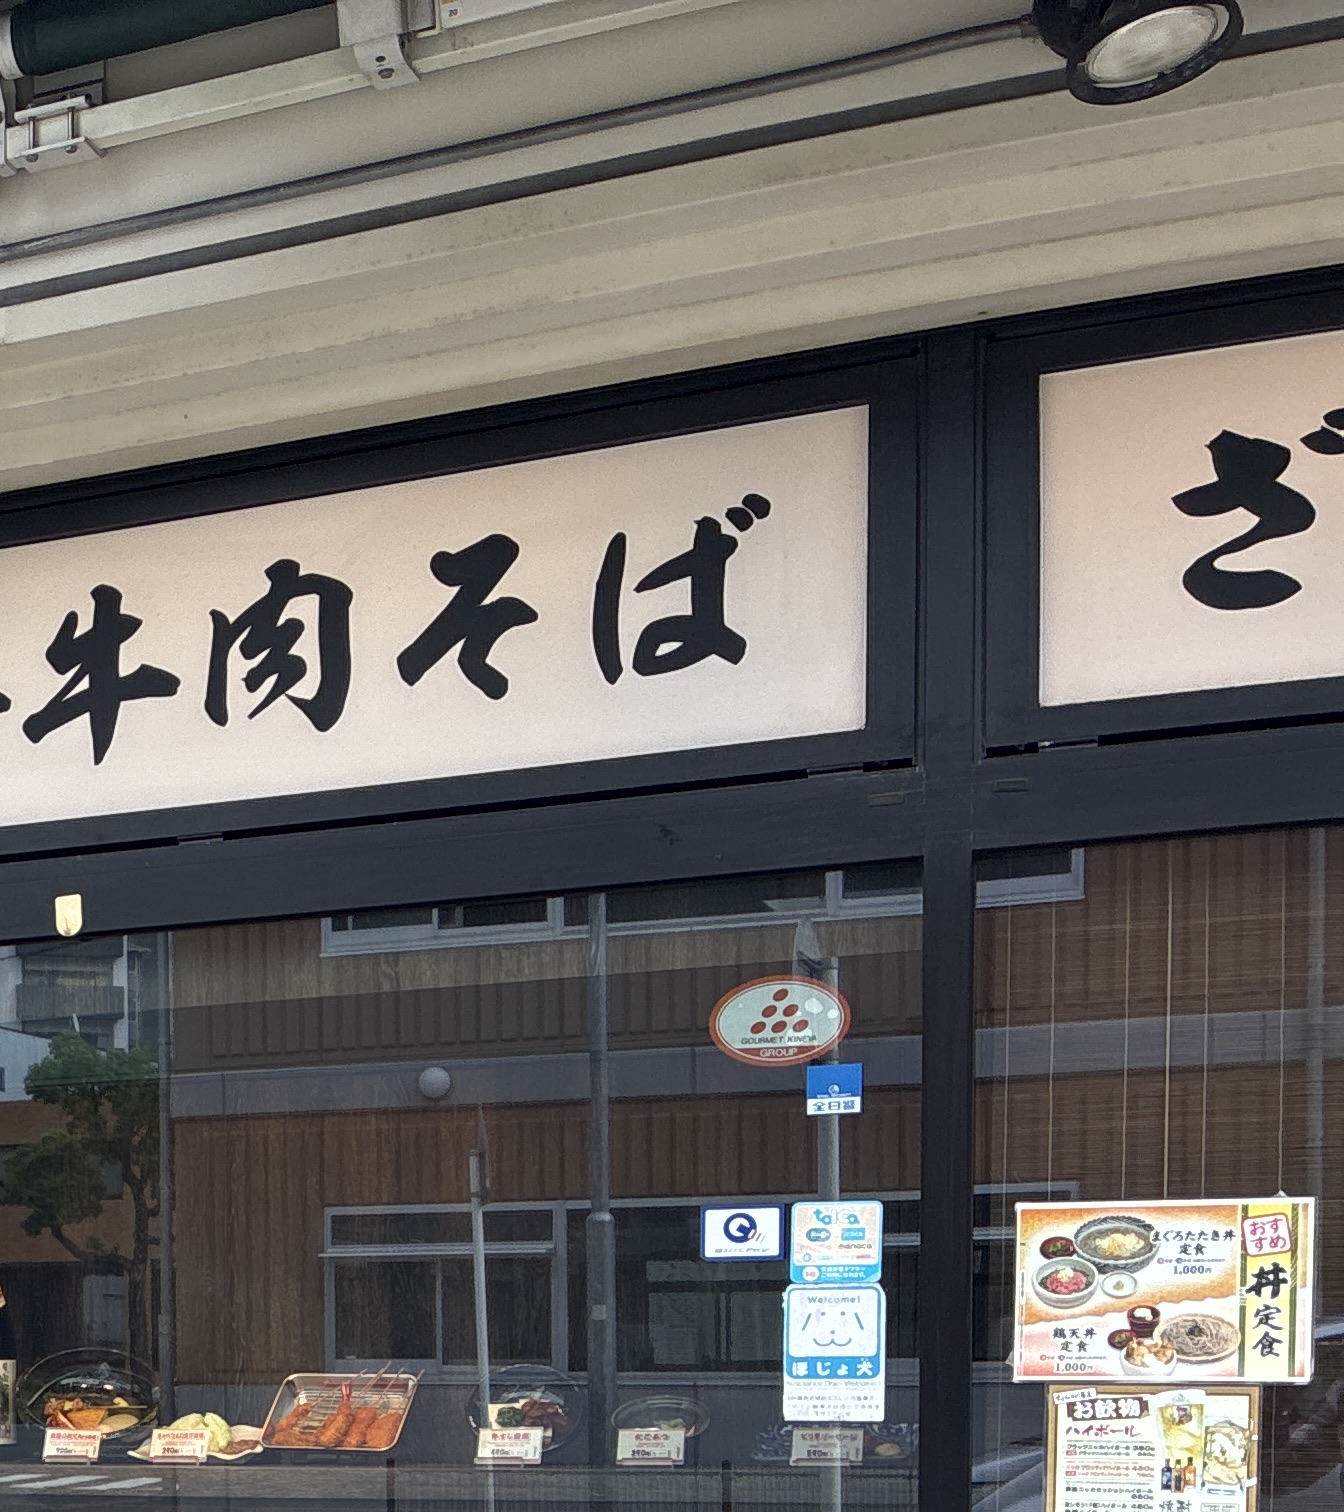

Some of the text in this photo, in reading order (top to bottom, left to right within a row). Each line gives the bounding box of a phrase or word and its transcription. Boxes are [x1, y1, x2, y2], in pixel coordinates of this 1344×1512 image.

[759, 1047, 798, 1057] GROUP
[1151, 1229, 1237, 1242] まぐろたたき丼
[1178, 1242, 1208, 1257] 定食
[806, 1295, 861, 1305] Welcome!
[1245, 1262, 1289, 1358] 丼定食
[1051, 1326, 1098, 1341] 鶏天丼
[1059, 1339, 1090, 1353] 定食
